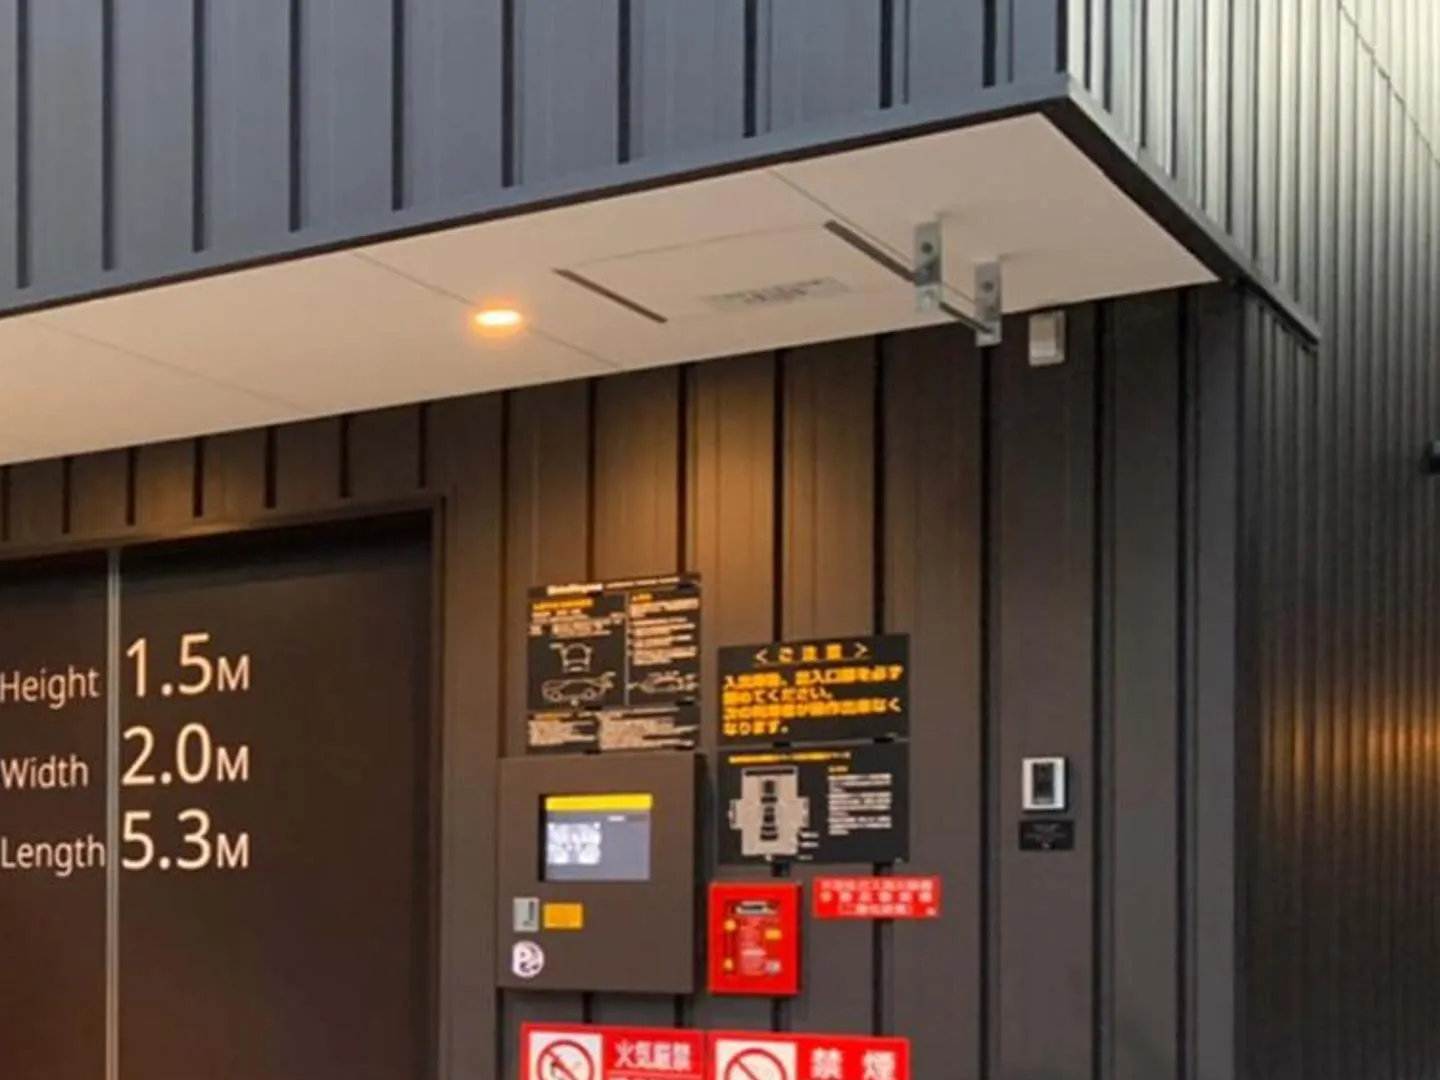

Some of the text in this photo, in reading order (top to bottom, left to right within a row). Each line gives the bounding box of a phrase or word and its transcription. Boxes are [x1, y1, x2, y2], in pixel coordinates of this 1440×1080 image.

[0, 665, 100, 710] Height
[126, 631, 251, 698] 1.5M
[0, 722, 250, 790] Width 2.0M
[0, 808, 250, 878] Length 5.3M
